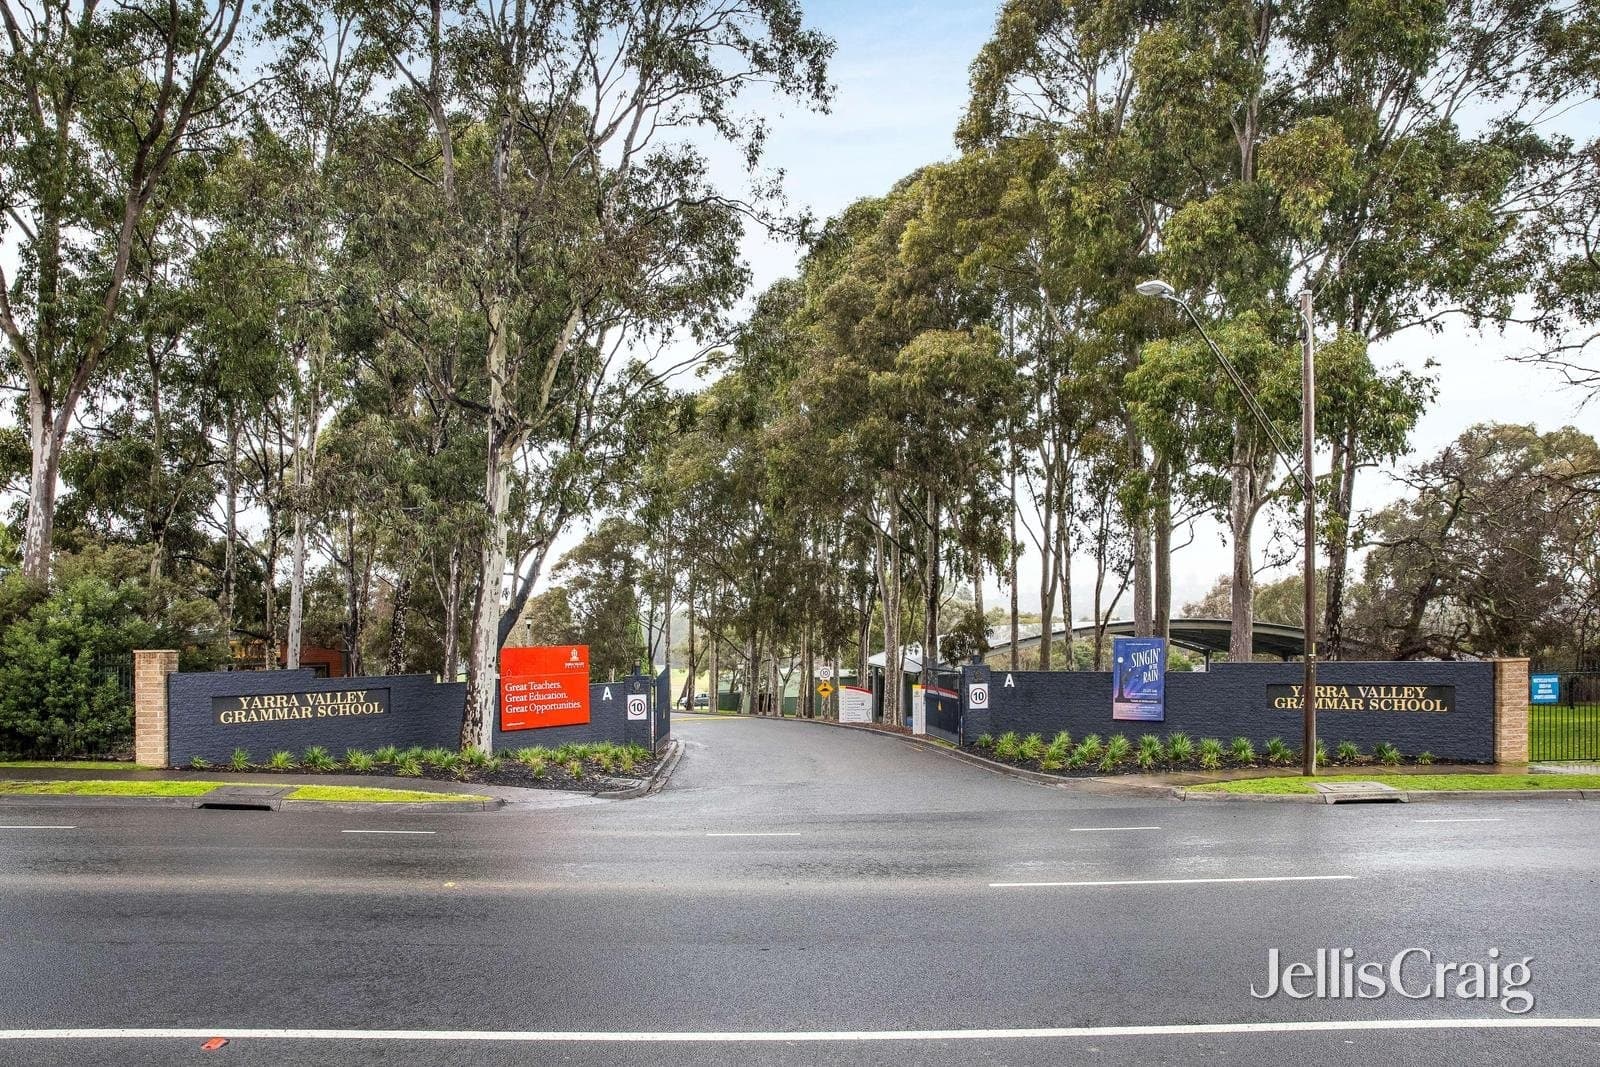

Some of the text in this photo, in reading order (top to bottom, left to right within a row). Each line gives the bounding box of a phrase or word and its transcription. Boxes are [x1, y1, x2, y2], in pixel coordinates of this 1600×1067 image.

[1131, 648, 1160, 668] SINGIN'
[1004, 674, 1015, 688] A
[1142, 670, 1158, 683] RAIN
[505, 680, 562, 692] Great Teachers.
[1290, 685, 1428, 699] YRRA VALLEY
[238, 690, 367, 710] YARRA VALLEY
[505, 691, 568, 703] Great Education.
[602, 686, 613, 701] A
[973, 692, 985, 701] 10
[505, 700, 582, 714] Great Opportunities.
[631, 702, 643, 712] 10
[1369, 698, 1448, 712] SCHOOL
[220, 702, 384, 724] GRAMMAR SCHOOL
